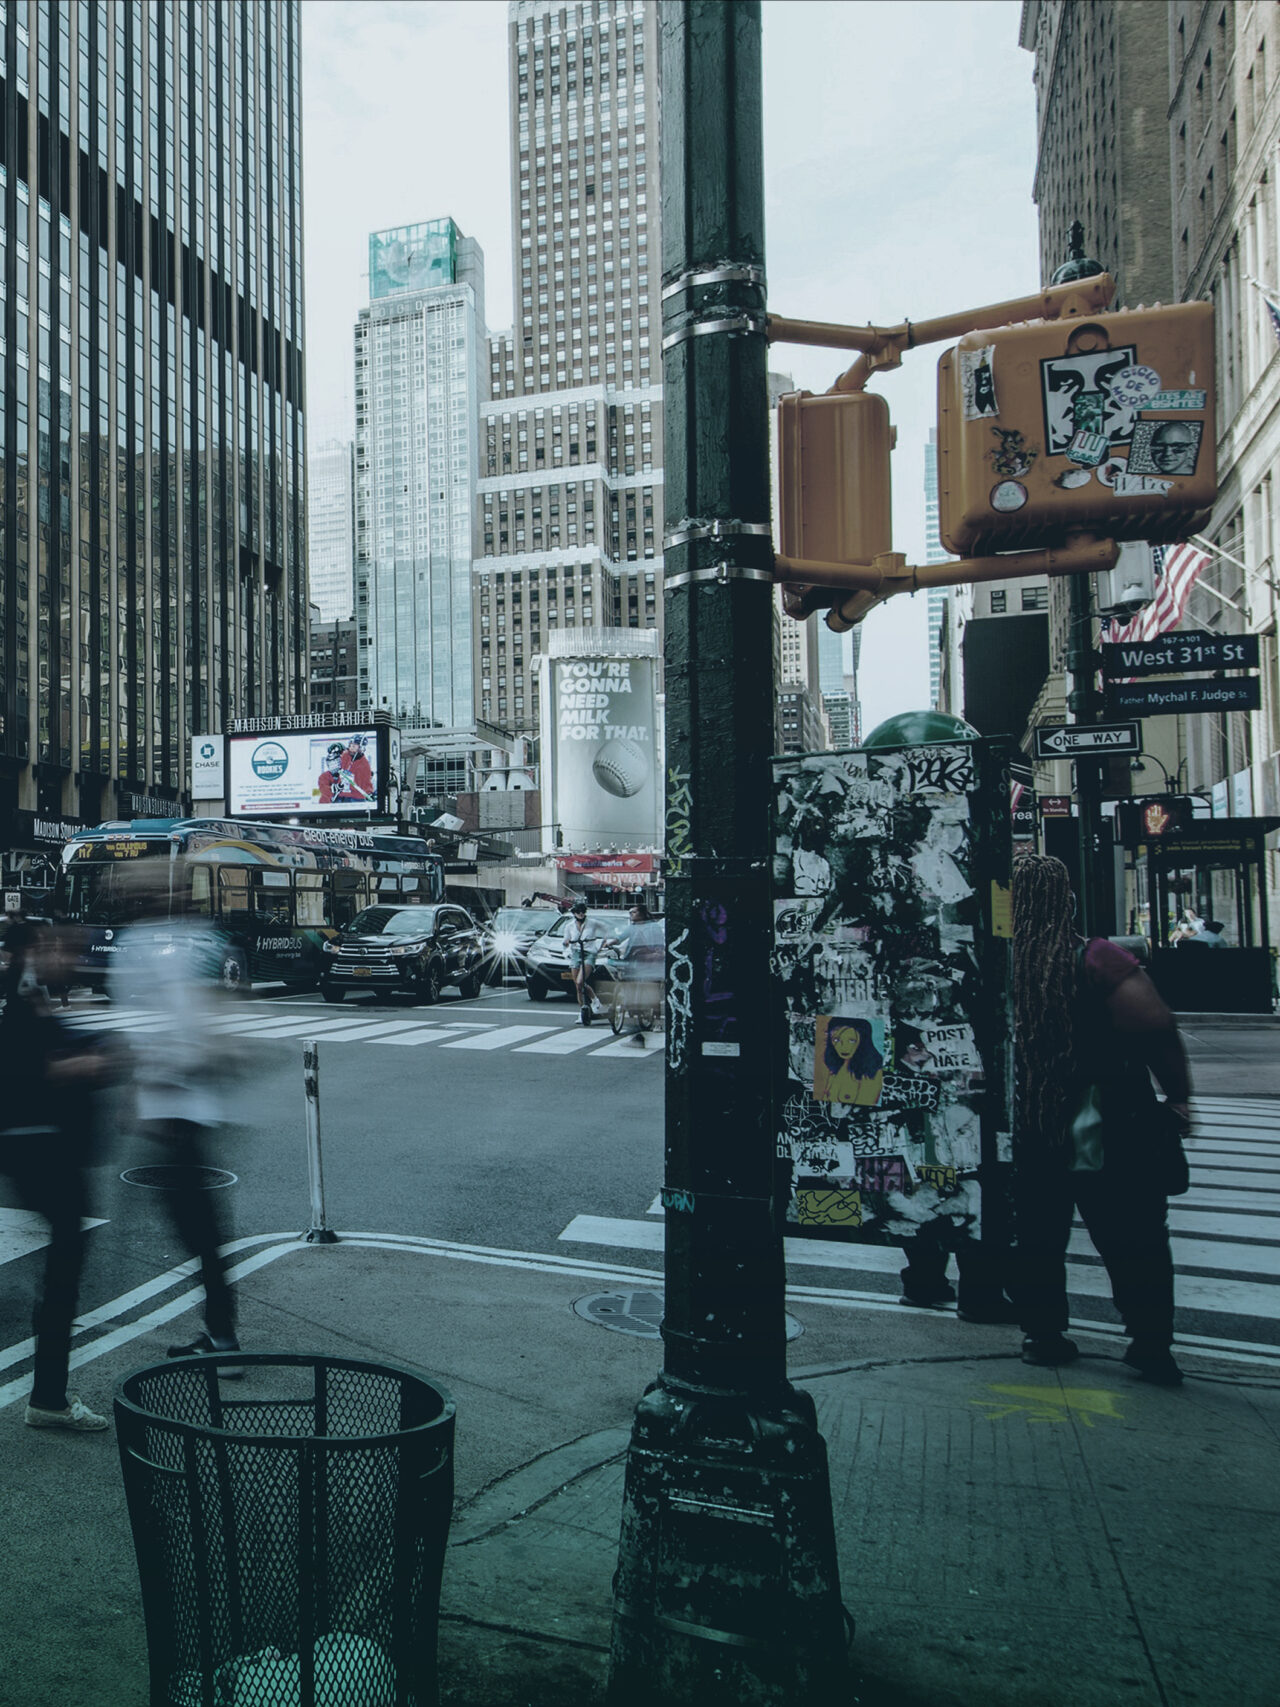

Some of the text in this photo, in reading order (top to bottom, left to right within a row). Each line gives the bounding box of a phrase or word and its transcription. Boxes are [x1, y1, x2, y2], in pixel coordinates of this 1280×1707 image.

[1162, 635, 1201, 644] 167 101
[1121, 643, 1245, 667] West 31st St
[560, 662, 630, 678] YOU'RE
[560, 678, 632, 694] GONNA
[560, 693, 610, 710] NEED
[1147, 691, 1188, 705] Mychal
[1201, 689, 1236, 702] Judge
[233, 711, 375, 732] MADISON SQUARE GARDEN
[560, 709, 610, 725] MILK
[560, 725, 649, 740] FOR THAT.
[1053, 732, 1122, 746] ONE WAY
[195, 761, 221, 769] CHASE
[1012, 811, 1033, 820] rea
[33, 818, 60, 839] MADISON
[115, 842, 148, 850] COLUMBUS
[303, 829, 375, 849] clean-energy bus
[78, 843, 94, 859] M7
[7, 894, 20, 902] GATE
[261, 936, 303, 950] HYBRIDBUS
[926, 1027, 967, 1043] POST
